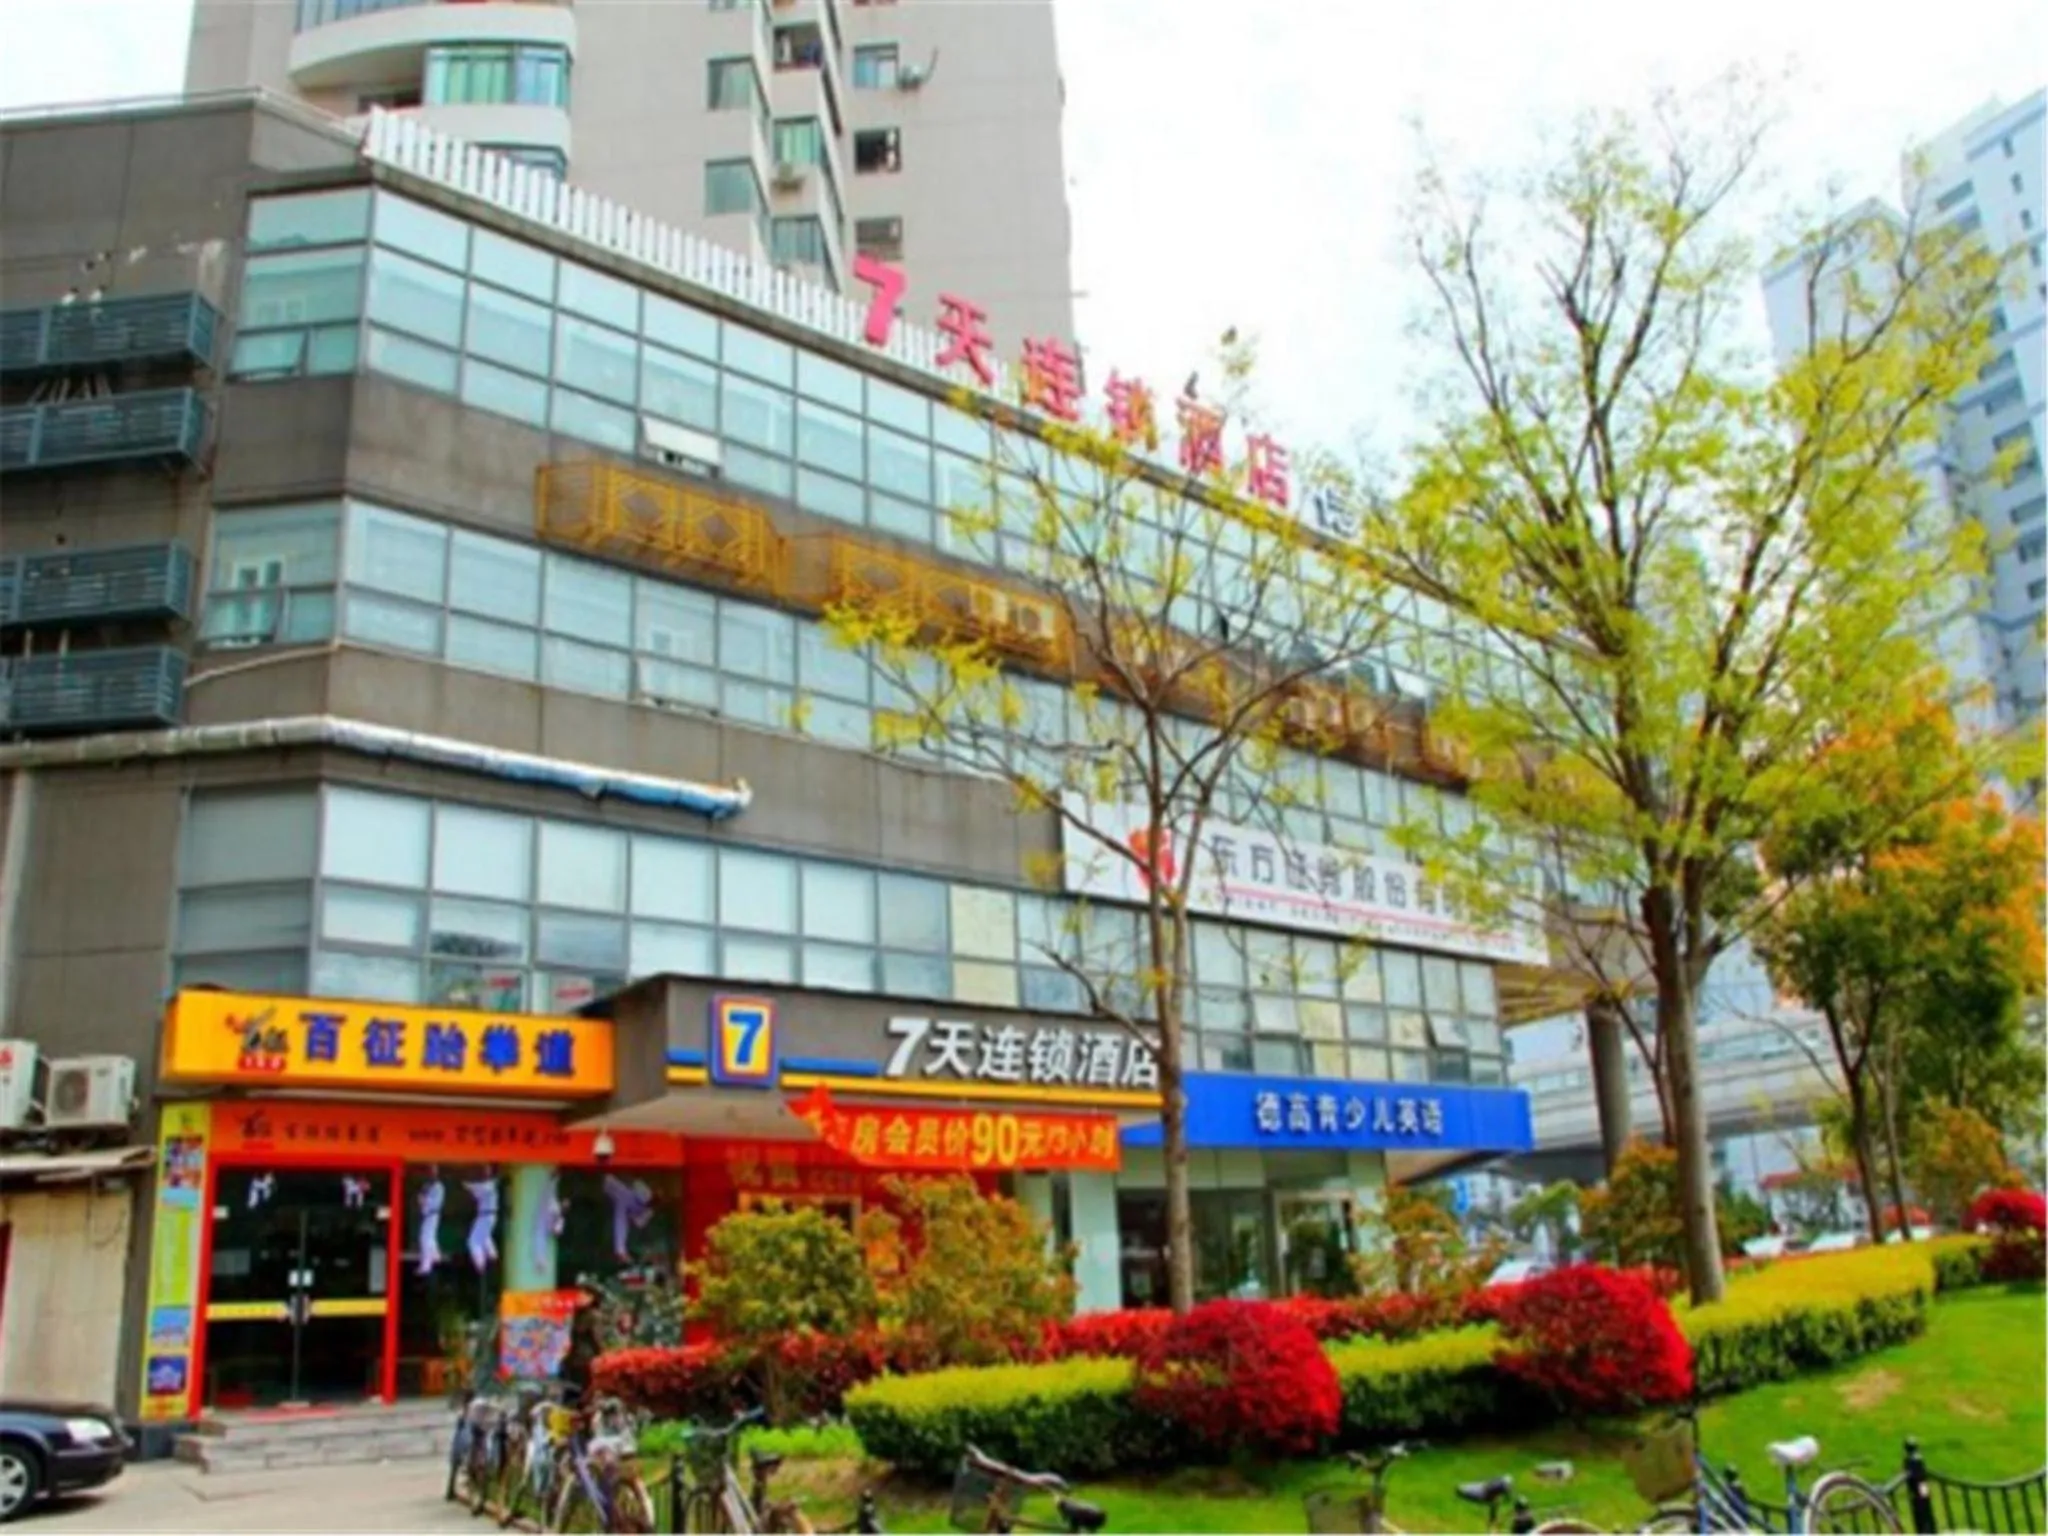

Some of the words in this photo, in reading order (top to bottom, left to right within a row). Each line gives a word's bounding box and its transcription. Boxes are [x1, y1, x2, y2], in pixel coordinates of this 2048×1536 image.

[728, 1012, 764, 1066] 7
[883, 1015, 1161, 1087] 7天连锁酒店
[1256, 1090, 1444, 1136] 德高青少儿英语
